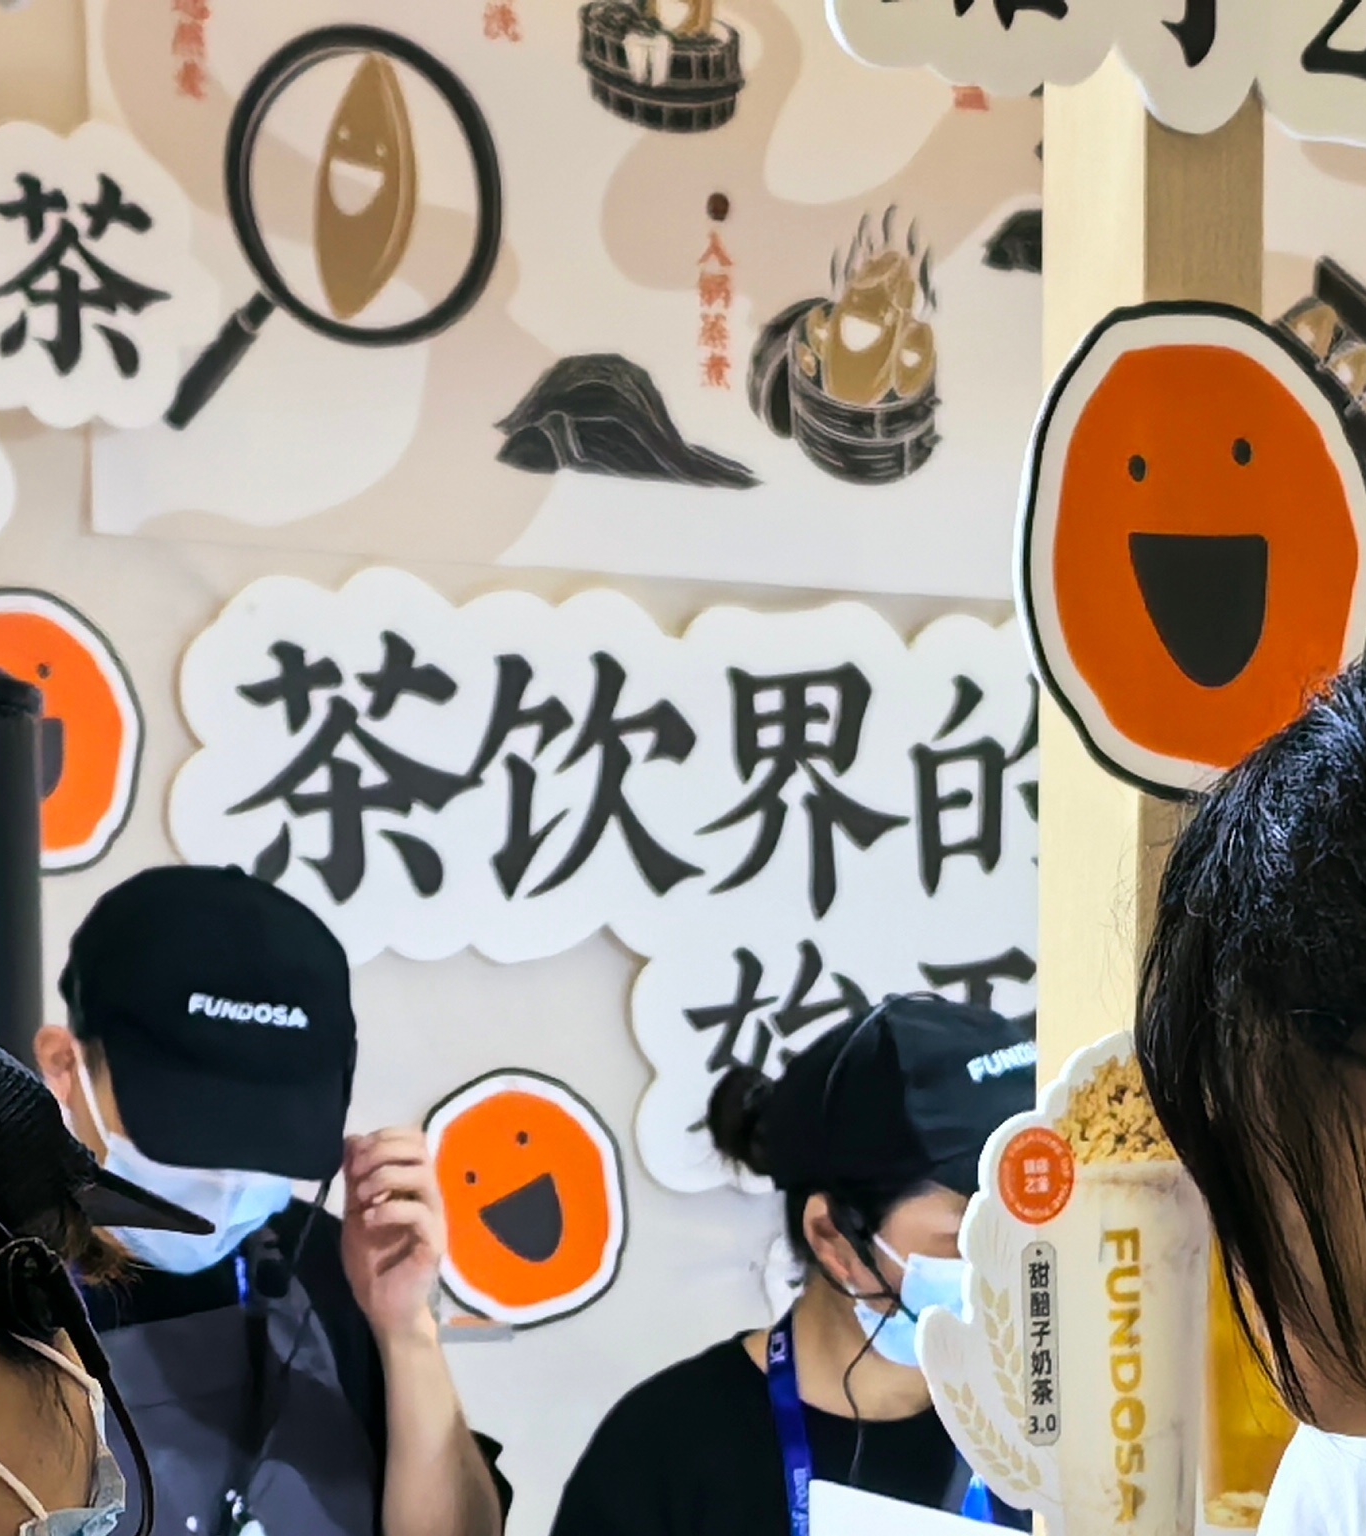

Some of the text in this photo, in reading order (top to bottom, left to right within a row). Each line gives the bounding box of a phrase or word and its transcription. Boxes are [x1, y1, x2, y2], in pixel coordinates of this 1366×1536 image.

[225, 630, 1040, 920] 茶饮界的
[188, 992, 310, 1029] FUNDOSA
[1103, 1226, 1147, 1524] FUNDOSA
